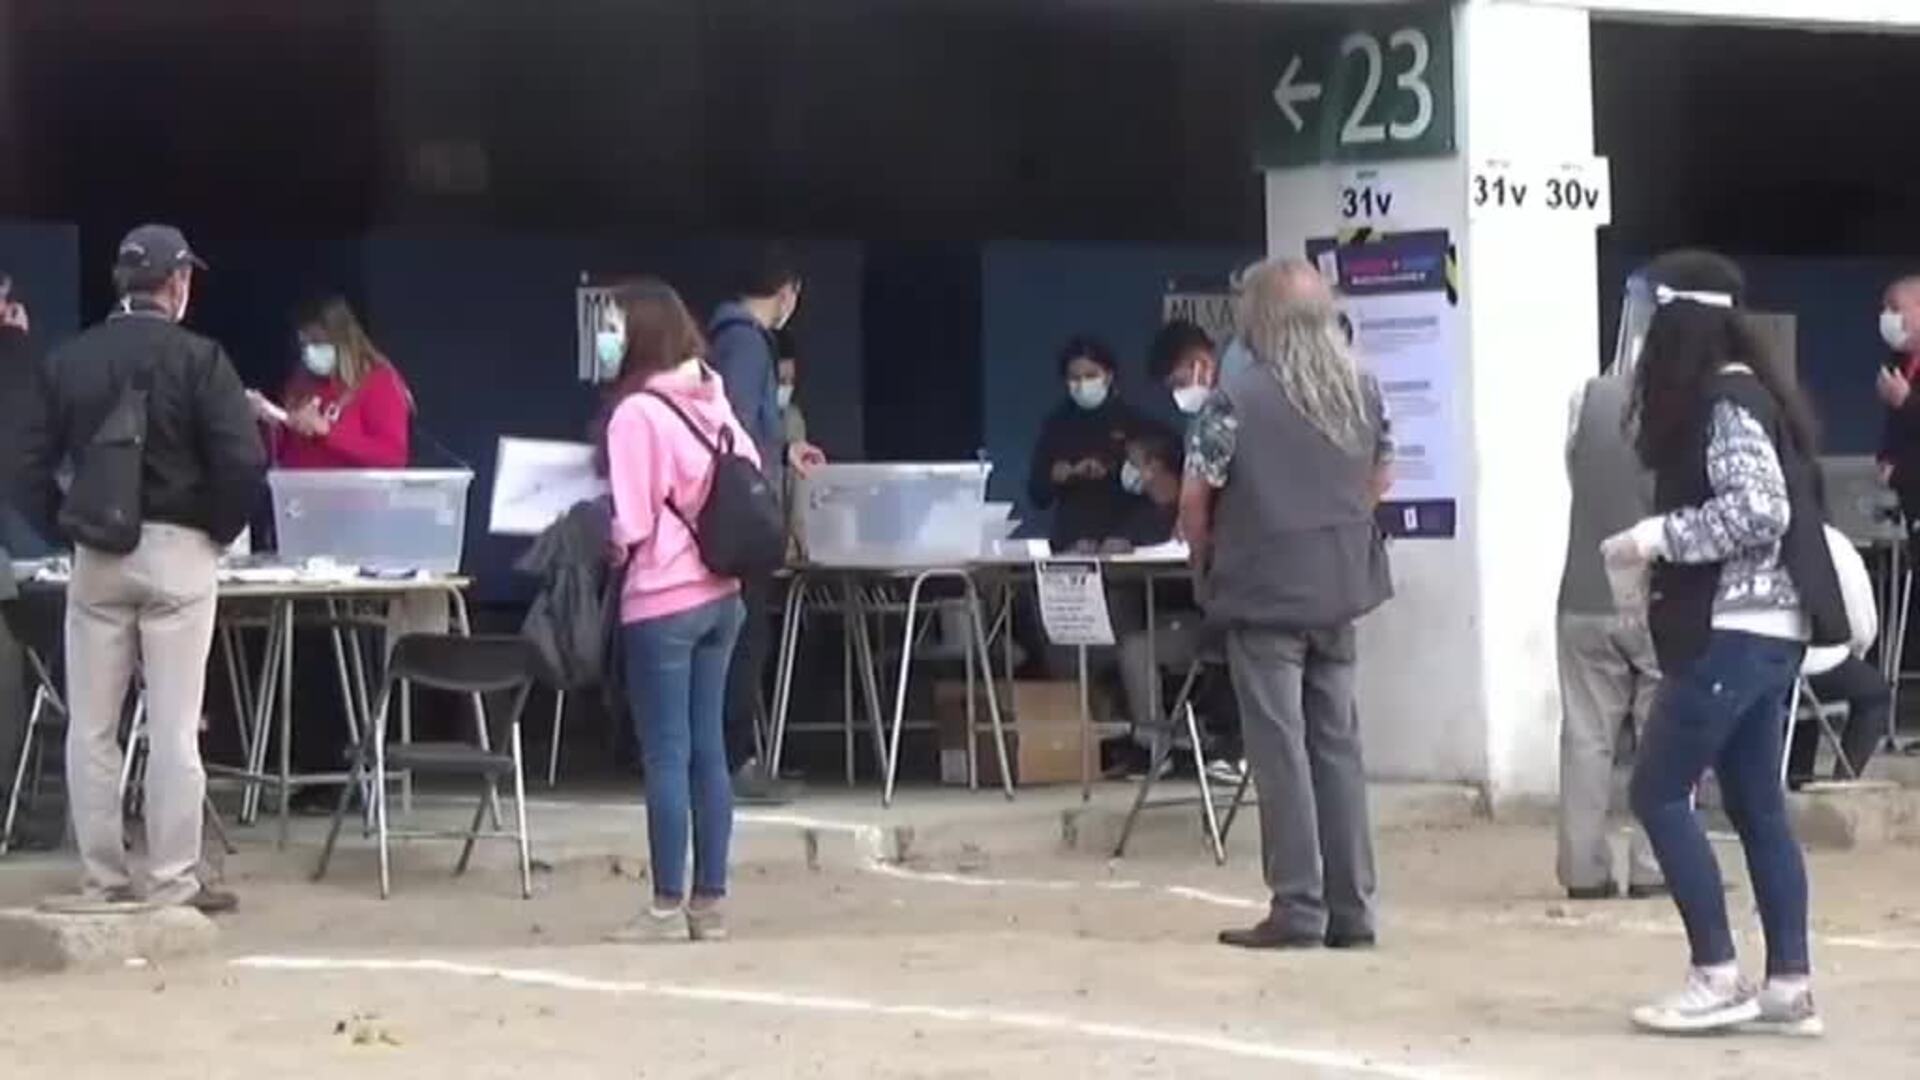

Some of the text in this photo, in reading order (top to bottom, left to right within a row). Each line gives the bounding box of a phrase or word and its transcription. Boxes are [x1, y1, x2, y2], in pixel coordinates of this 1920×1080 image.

[1340, 27, 1434, 145] 23
[1342, 186, 1392, 219] 31v
[1474, 174, 1527, 207] 31v
[1545, 178, 1599, 210] 30v
